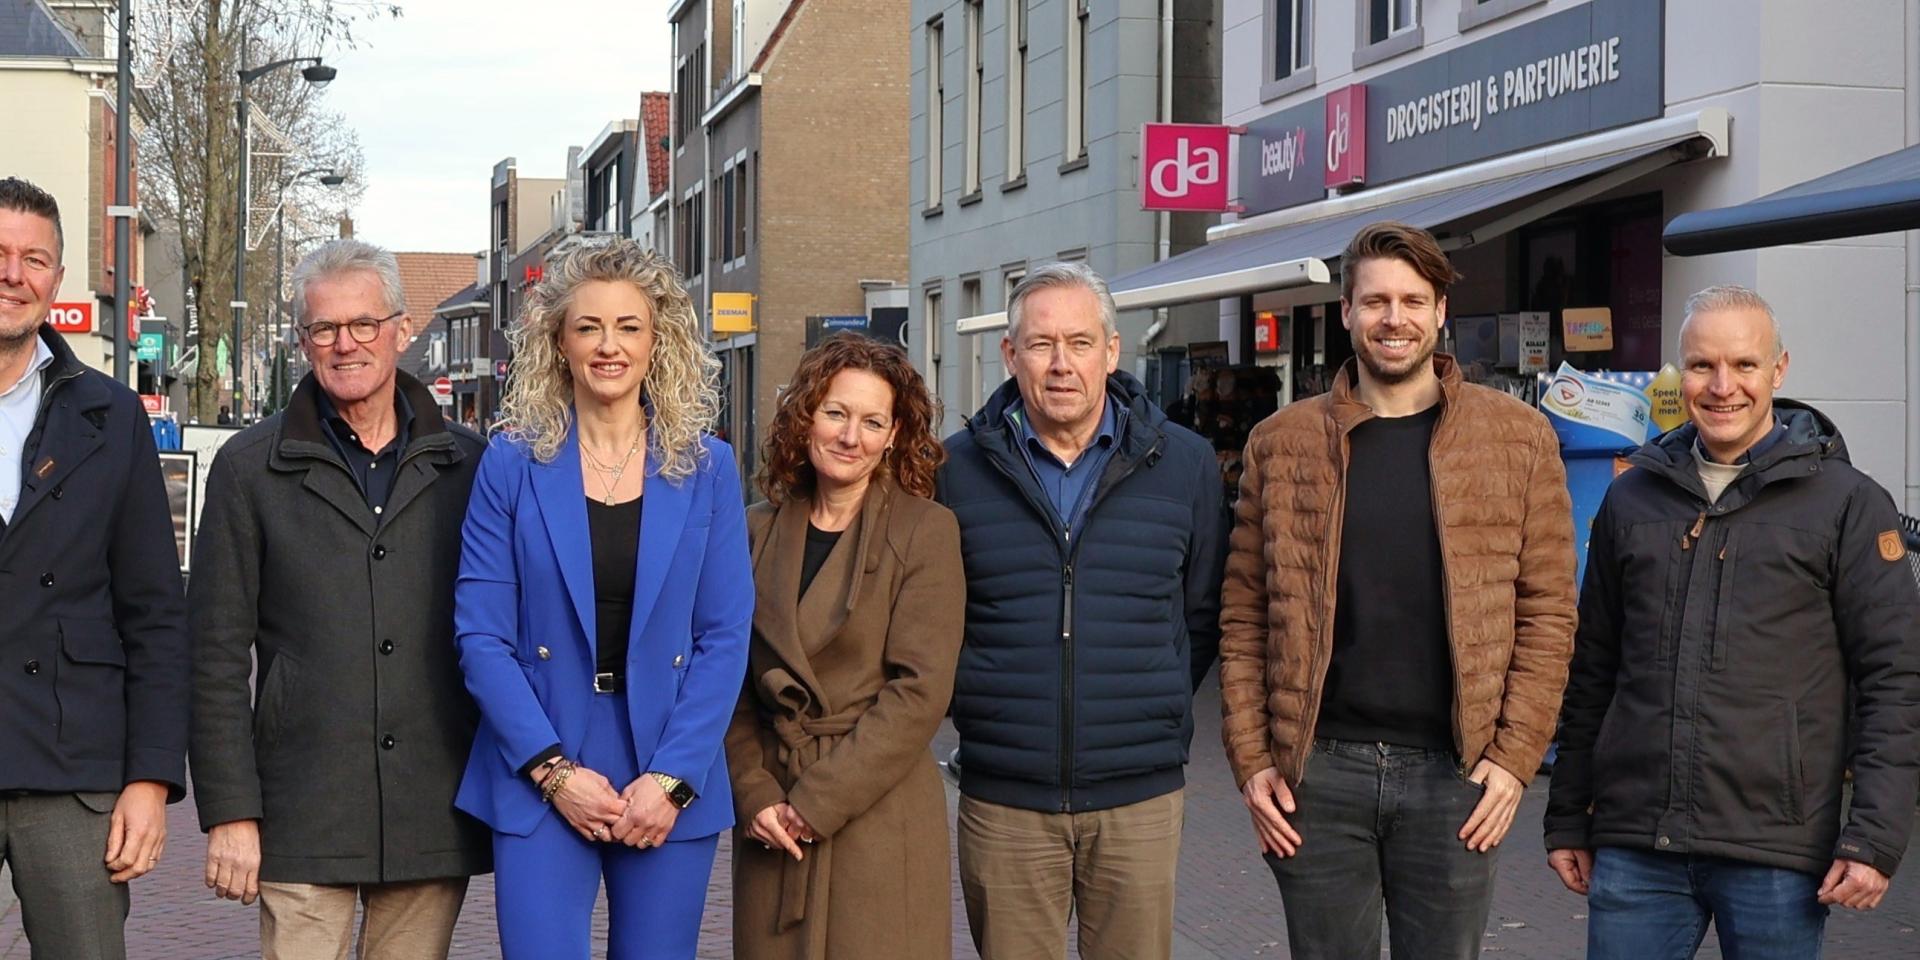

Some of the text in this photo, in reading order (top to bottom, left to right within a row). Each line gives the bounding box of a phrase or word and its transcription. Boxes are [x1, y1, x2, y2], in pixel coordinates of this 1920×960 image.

[1387, 37, 1620, 143] DROGISTERIJ & PARFUMERIE
[1327, 104, 1348, 172] da
[1150, 138, 1219, 197] da
[45, 308, 84, 325] no
[1652, 388, 1678, 399] Speel
[1662, 398, 1679, 406] ook
[1658, 406, 1682, 415] mee?
